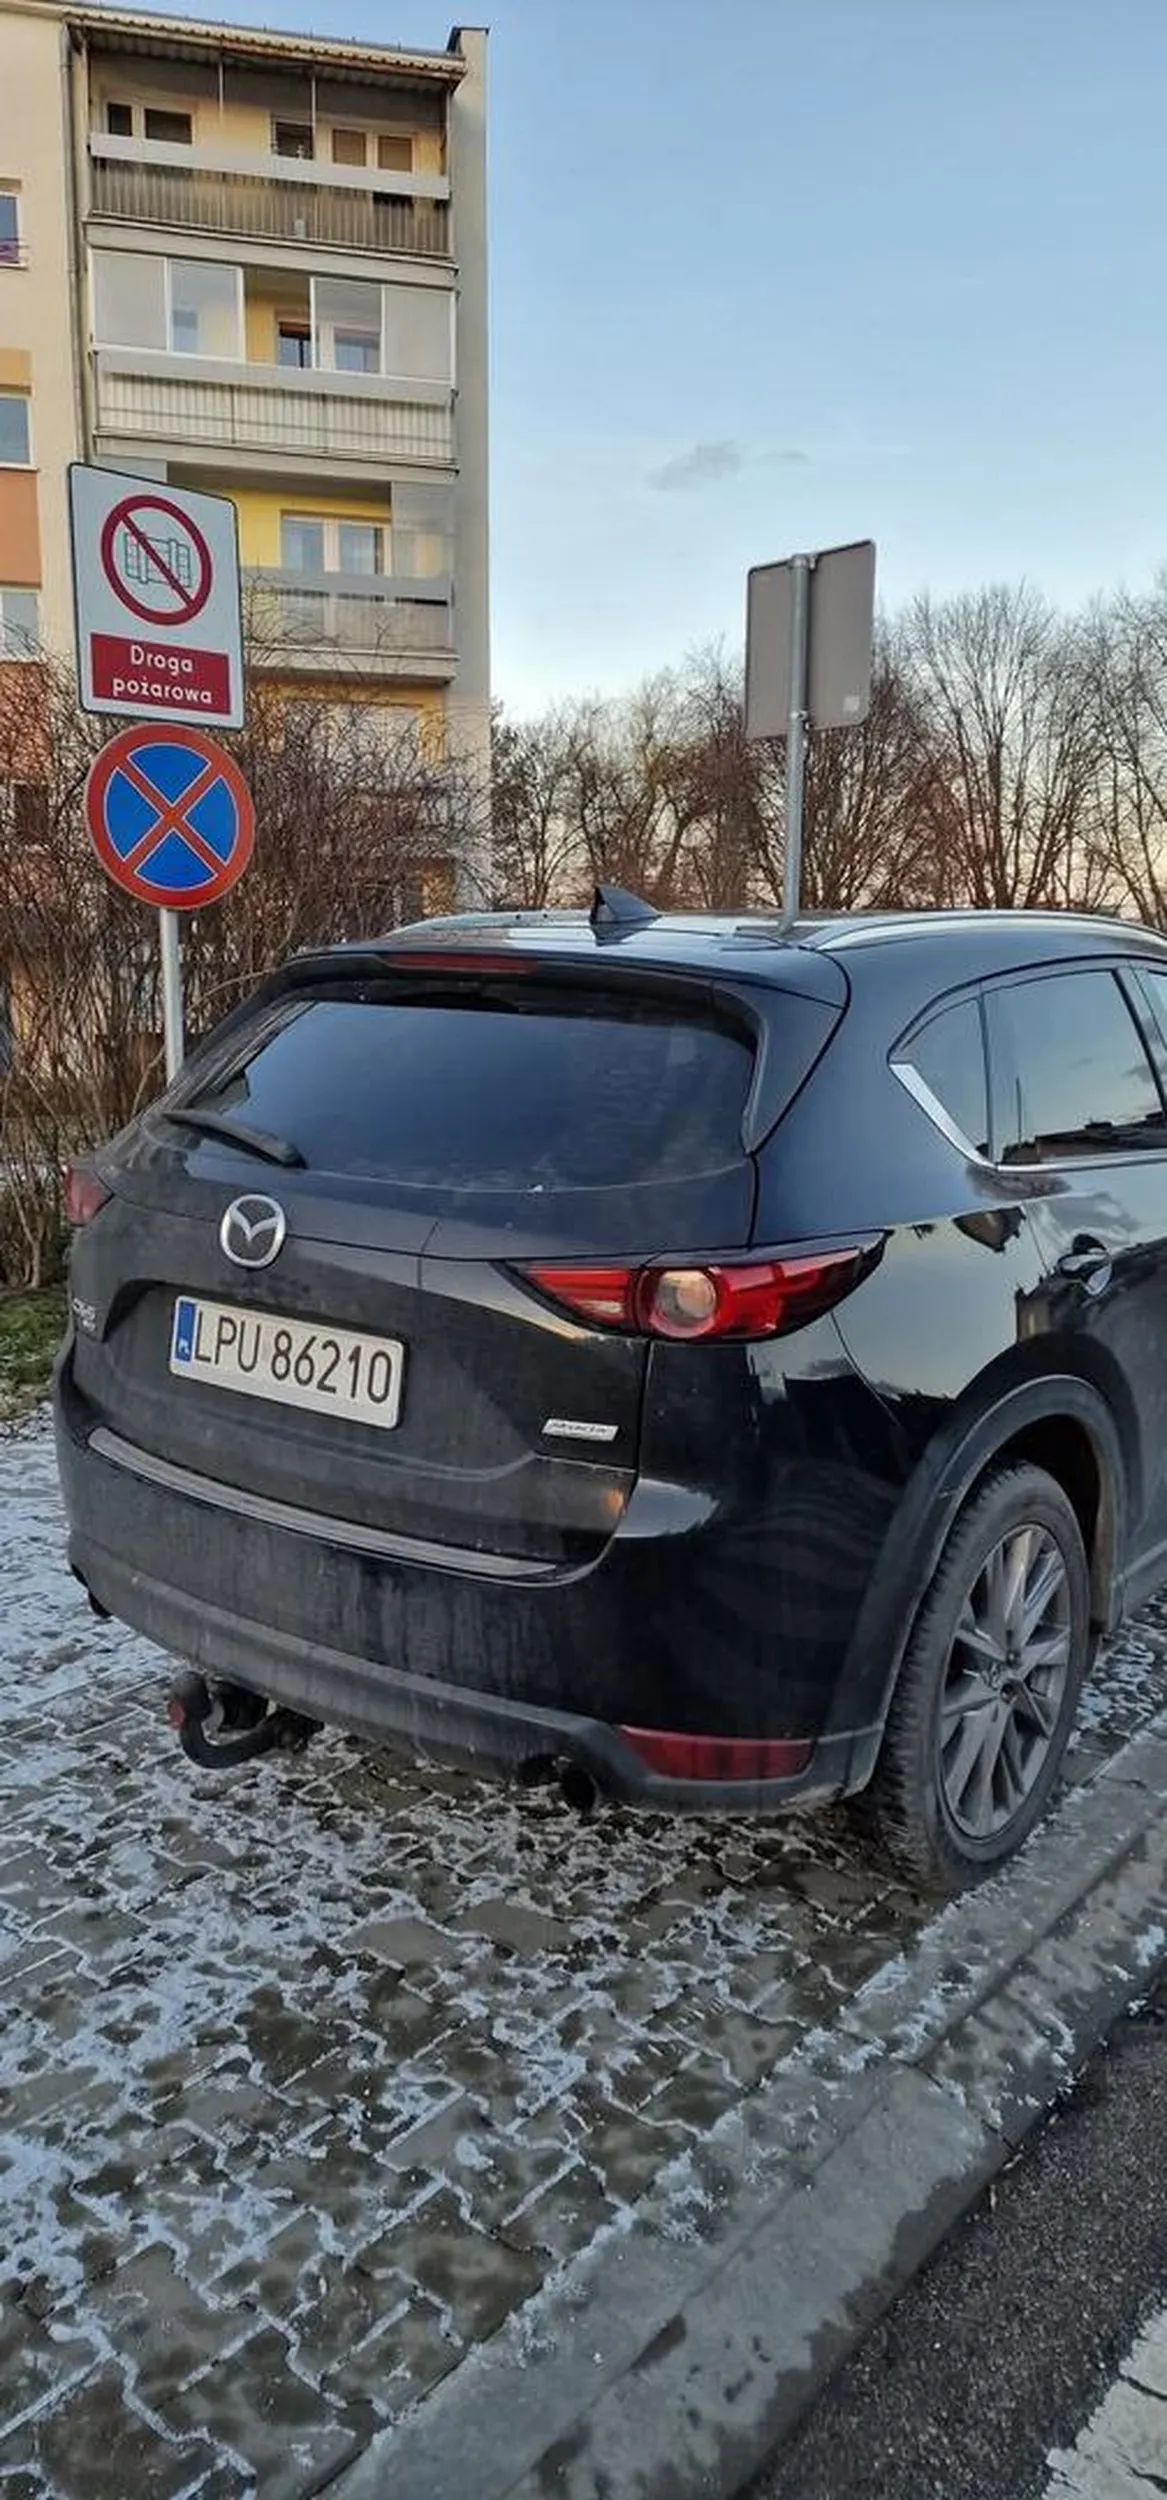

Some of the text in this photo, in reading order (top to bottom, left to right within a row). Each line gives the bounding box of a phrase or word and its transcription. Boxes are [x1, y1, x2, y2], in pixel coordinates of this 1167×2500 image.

[130, 645, 193, 676] Droga
[112, 676, 212, 704] pożarowa
[194, 1310, 393, 1405] LPU 86210
